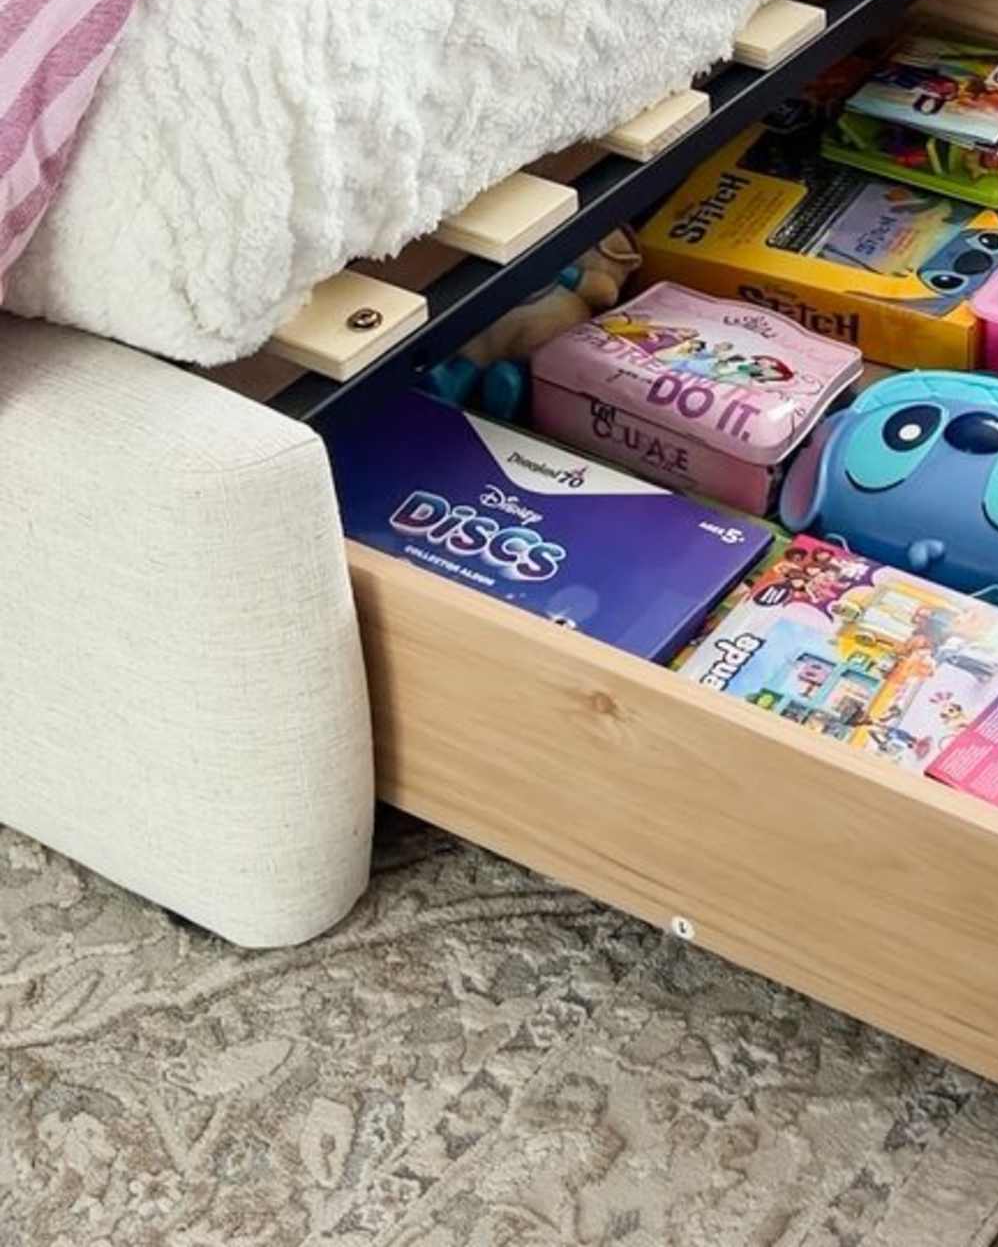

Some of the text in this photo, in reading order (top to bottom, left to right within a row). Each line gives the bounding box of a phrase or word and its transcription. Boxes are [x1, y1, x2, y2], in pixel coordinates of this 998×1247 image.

[646, 374, 715, 420] DO
[716, 399, 761, 442] IT.
[558, 470, 586, 488] 70
[480, 484, 544, 526] Disney
[404, 544, 497, 587] COLLECTOR ALBUM
